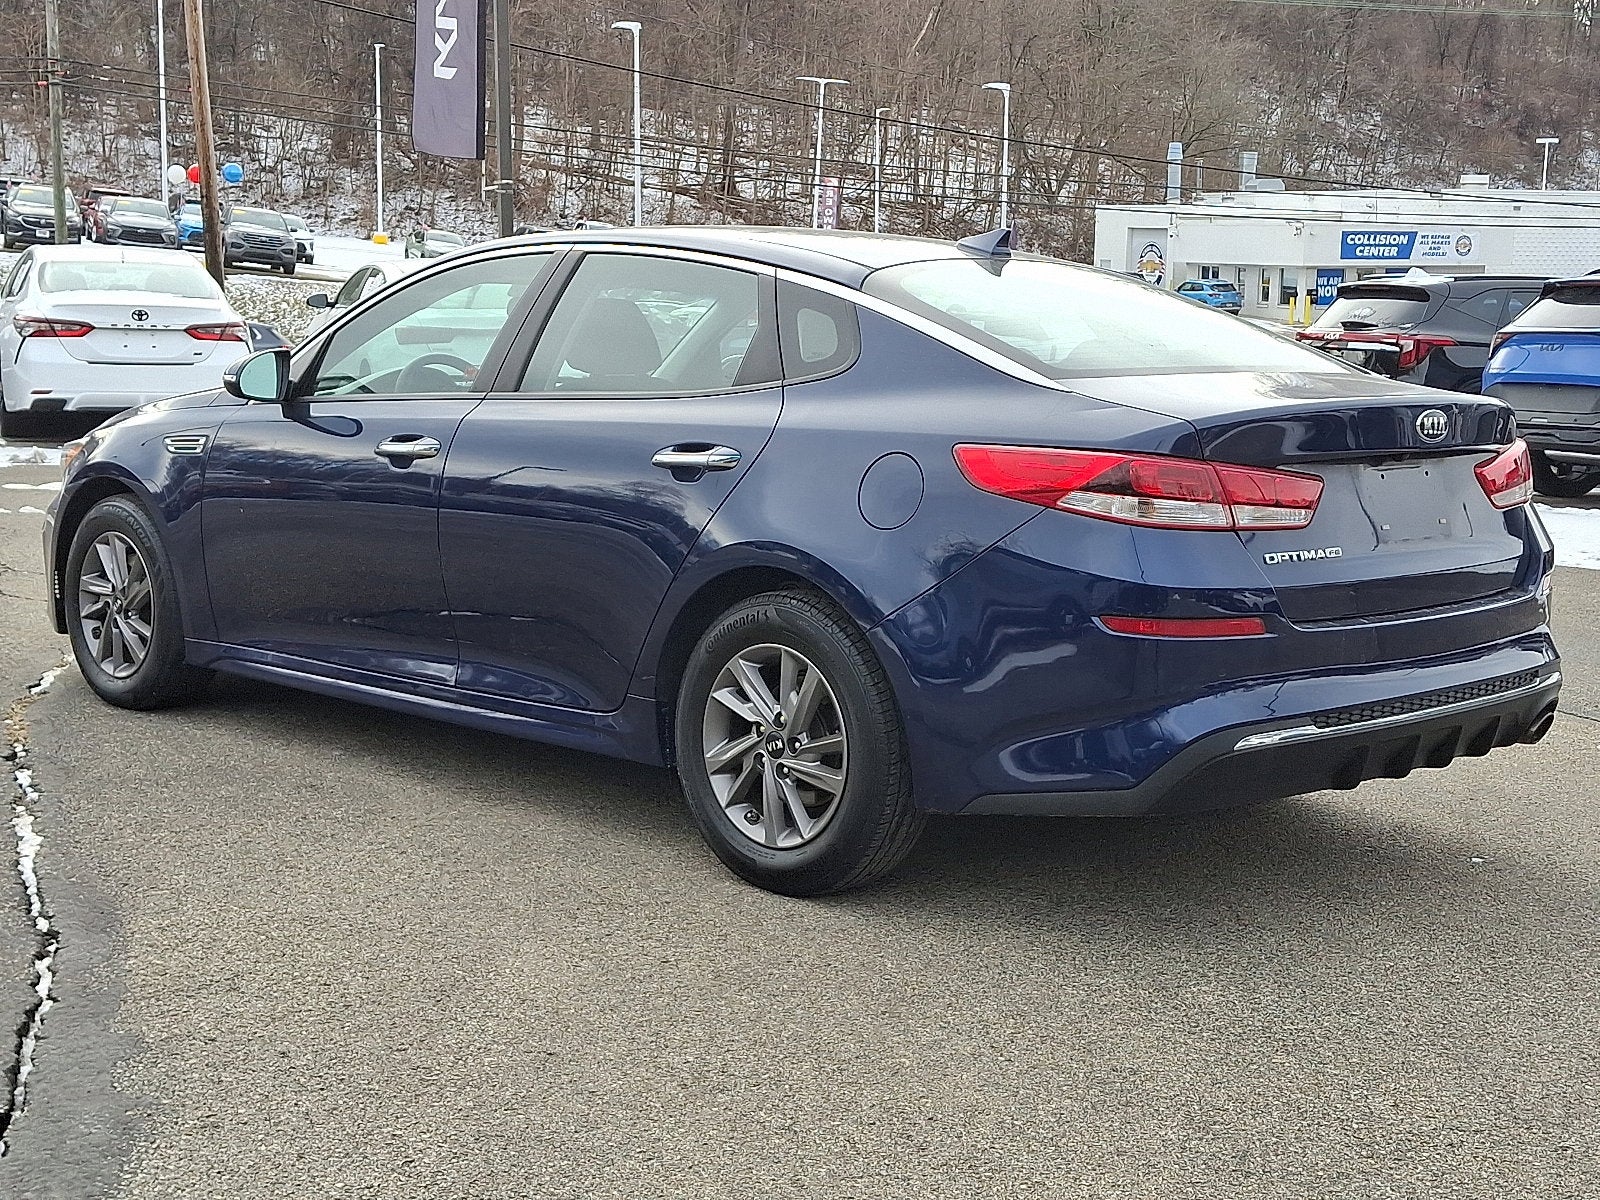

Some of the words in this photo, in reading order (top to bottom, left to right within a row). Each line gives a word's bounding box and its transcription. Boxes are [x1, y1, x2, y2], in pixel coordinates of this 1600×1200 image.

[1346, 234, 1409, 245] COLLISION
[1355, 246, 1399, 257] CENTER
[1317, 277, 1328, 286] WE
[1423, 416, 1446, 435] KIA
[1263, 549, 1326, 564] OPTIMA
[706, 610, 760, 652] Continental
[766, 738, 783, 752] KIA
